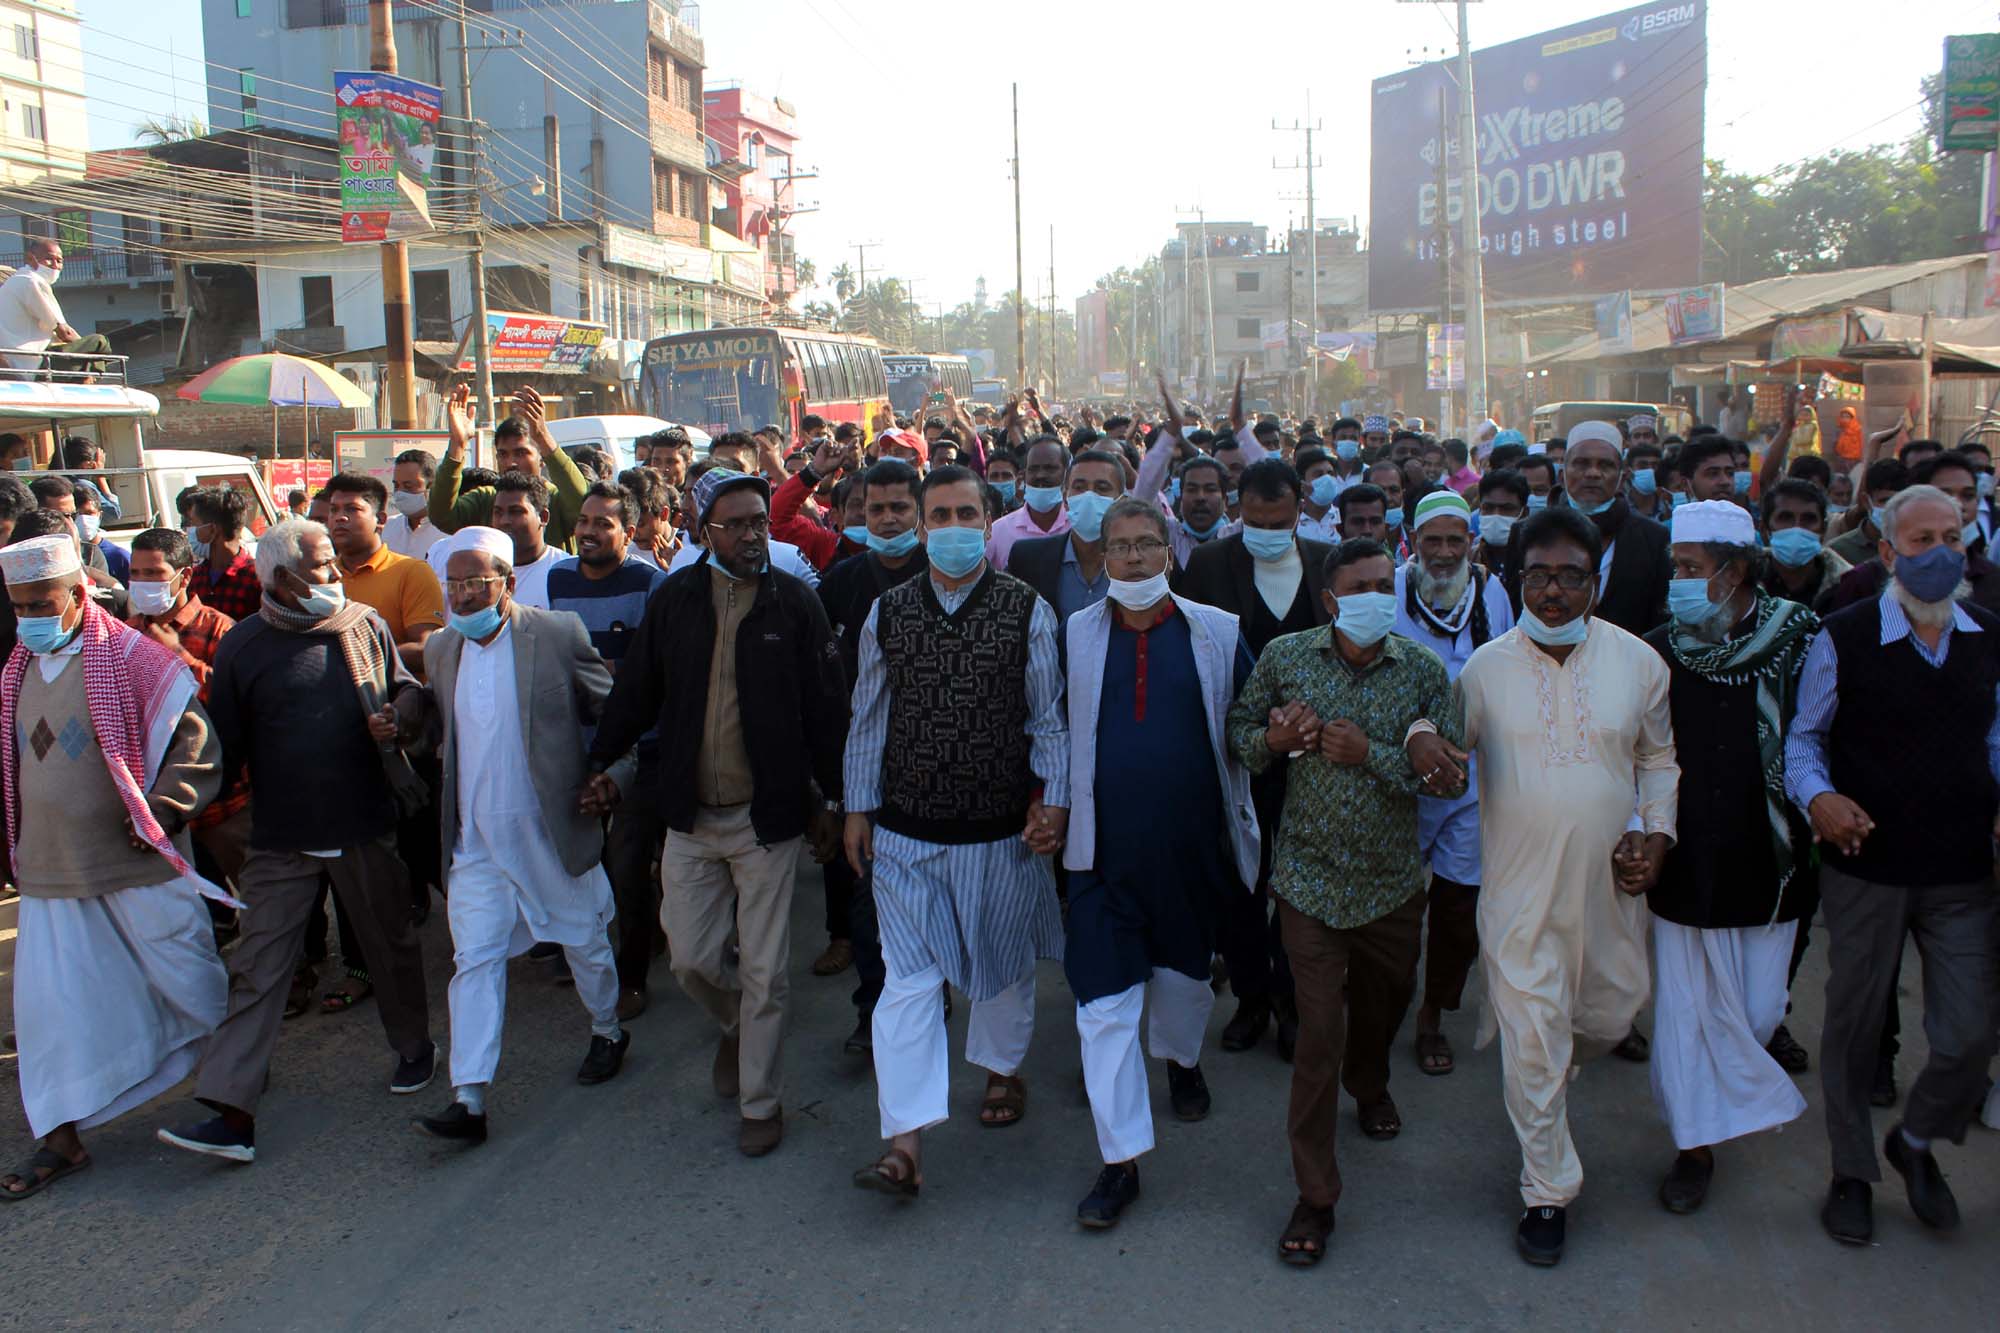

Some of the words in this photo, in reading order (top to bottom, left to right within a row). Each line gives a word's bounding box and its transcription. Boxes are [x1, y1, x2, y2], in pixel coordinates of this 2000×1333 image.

[1642, 4, 1696, 30] BSRM
[1481, 97, 1625, 166] Xtreme
[1527, 150, 1625, 211] DWR
[1554, 211, 1628, 246] steel
[647, 335, 774, 366] SHYAMOLI
